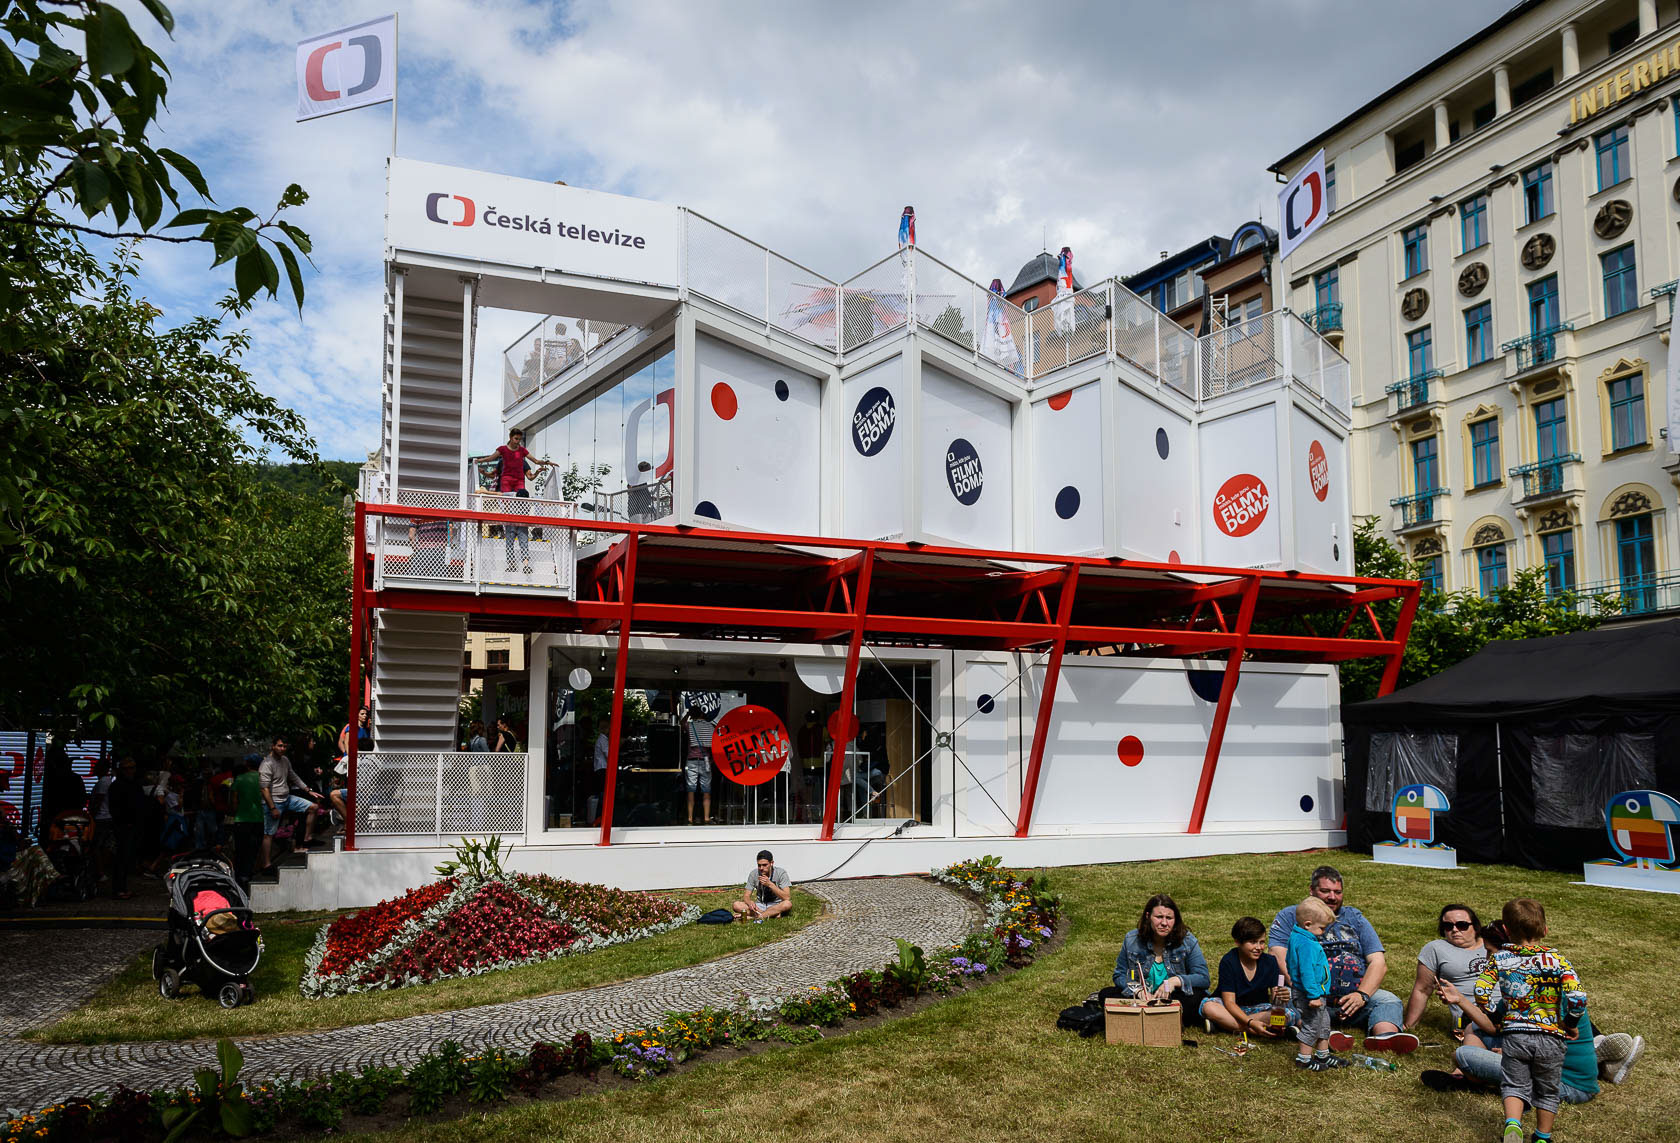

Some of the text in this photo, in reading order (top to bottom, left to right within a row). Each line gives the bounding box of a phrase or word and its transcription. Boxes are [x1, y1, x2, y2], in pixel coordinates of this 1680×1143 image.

[483, 205, 646, 250] Česká televize
[858, 395, 890, 441] FILMY
[861, 407, 896, 453] DOMA
[951, 457, 979, 484] FILMY
[954, 471, 984, 497] DOMA
[1220, 483, 1263, 522] FILMY
[1225, 494, 1269, 533] DOMA
[723, 723, 780, 761] FILMY
[729, 738, 792, 777] DOMA
